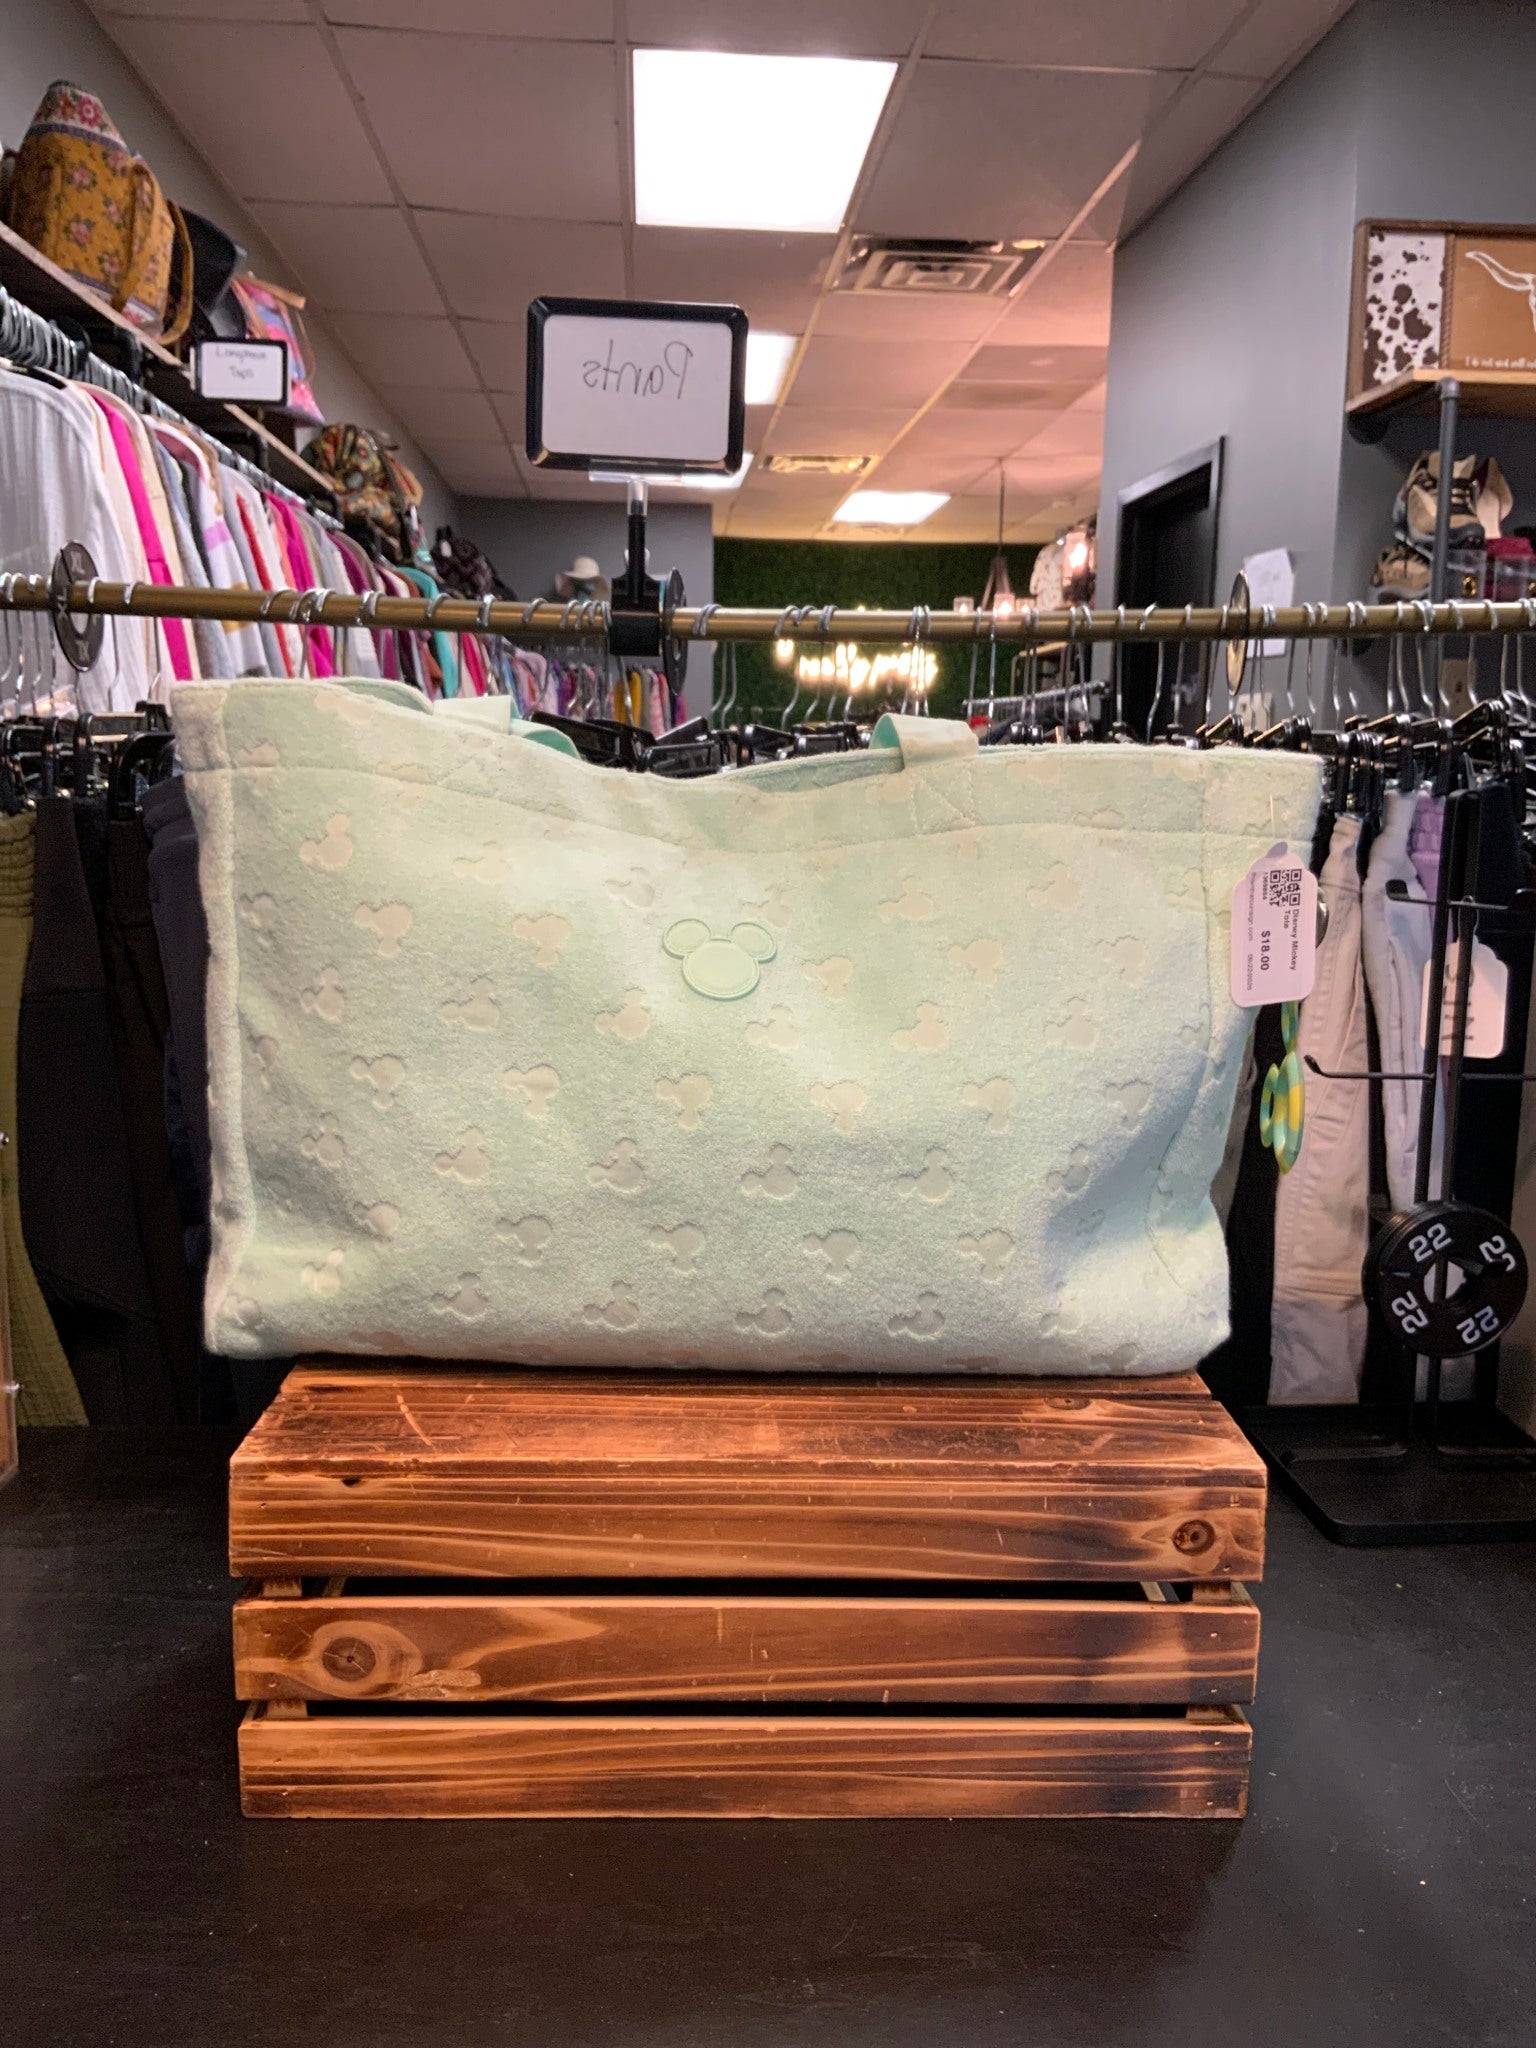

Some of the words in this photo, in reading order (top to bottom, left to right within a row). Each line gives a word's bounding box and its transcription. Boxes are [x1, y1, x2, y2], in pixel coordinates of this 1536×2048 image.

[1283, 910, 1291, 929] Tote
[1291, 908, 1300, 938] Disney
[1260, 930, 1271, 971] $18.00
[1289, 940, 1299, 971] Mickey
[1408, 1223, 1453, 1262] 22
[1391, 1290, 1429, 1334] 22
[1456, 1305, 1499, 1344] 22
